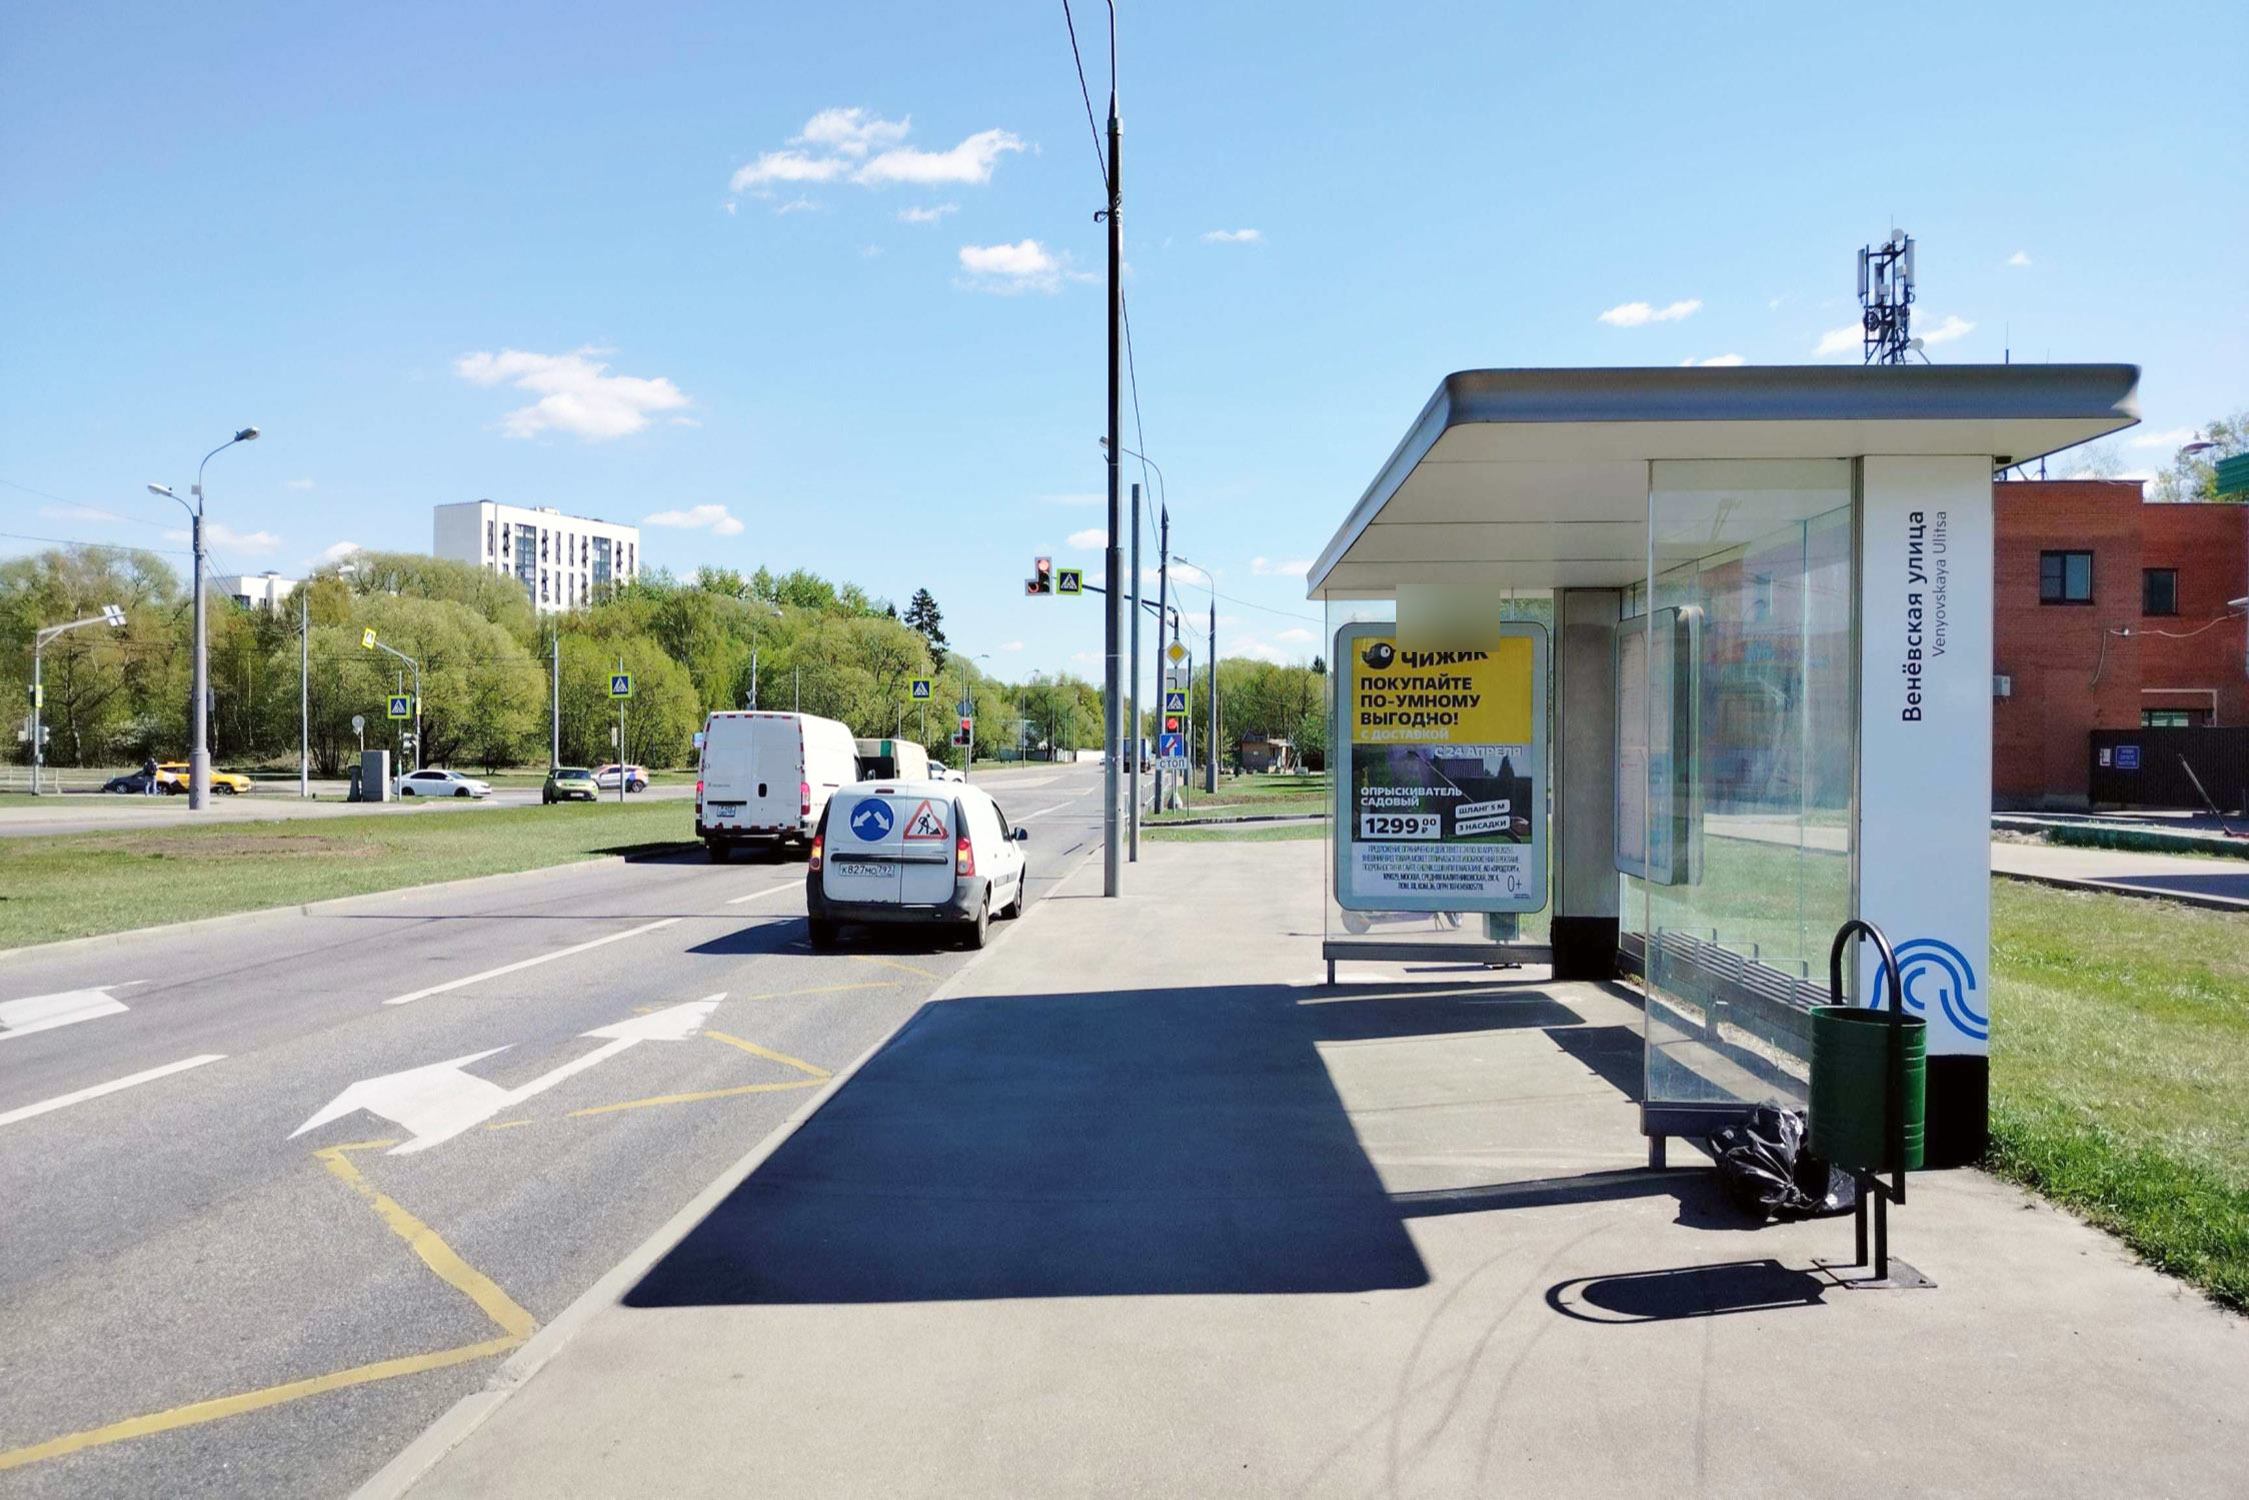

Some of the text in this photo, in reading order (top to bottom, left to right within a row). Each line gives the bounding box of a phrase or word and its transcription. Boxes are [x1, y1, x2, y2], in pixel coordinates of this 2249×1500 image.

[1932, 511, 1949, 658] Venyovskaya Ulitsa
[1902, 511, 1928, 722] Венёвская улица
[1360, 673, 1473, 690] ПОКУПАЙТЕ
[1360, 694, 1481, 708] ПО-УМНОМУ
[1360, 712, 1459, 728] ВЫГОДНО!
[1371, 728, 1449, 740] ДОСТАВКОЙ
[1445, 746, 1463, 757] 24
[1466, 746, 1523, 757] АПРЕЛЯ
[1159, 759, 1185, 768] СТОП
[1360, 787, 1463, 797] ОПРЫСКИВАТЕЛЬ
[1360, 796, 1420, 807] САДОВЫЙ
[1459, 805, 1490, 815] ШЛАНГ
[1365, 818, 1419, 834] 1299
[1465, 820, 1507, 832] НАСАДКИ
[1507, 875, 1522, 892] 0+
